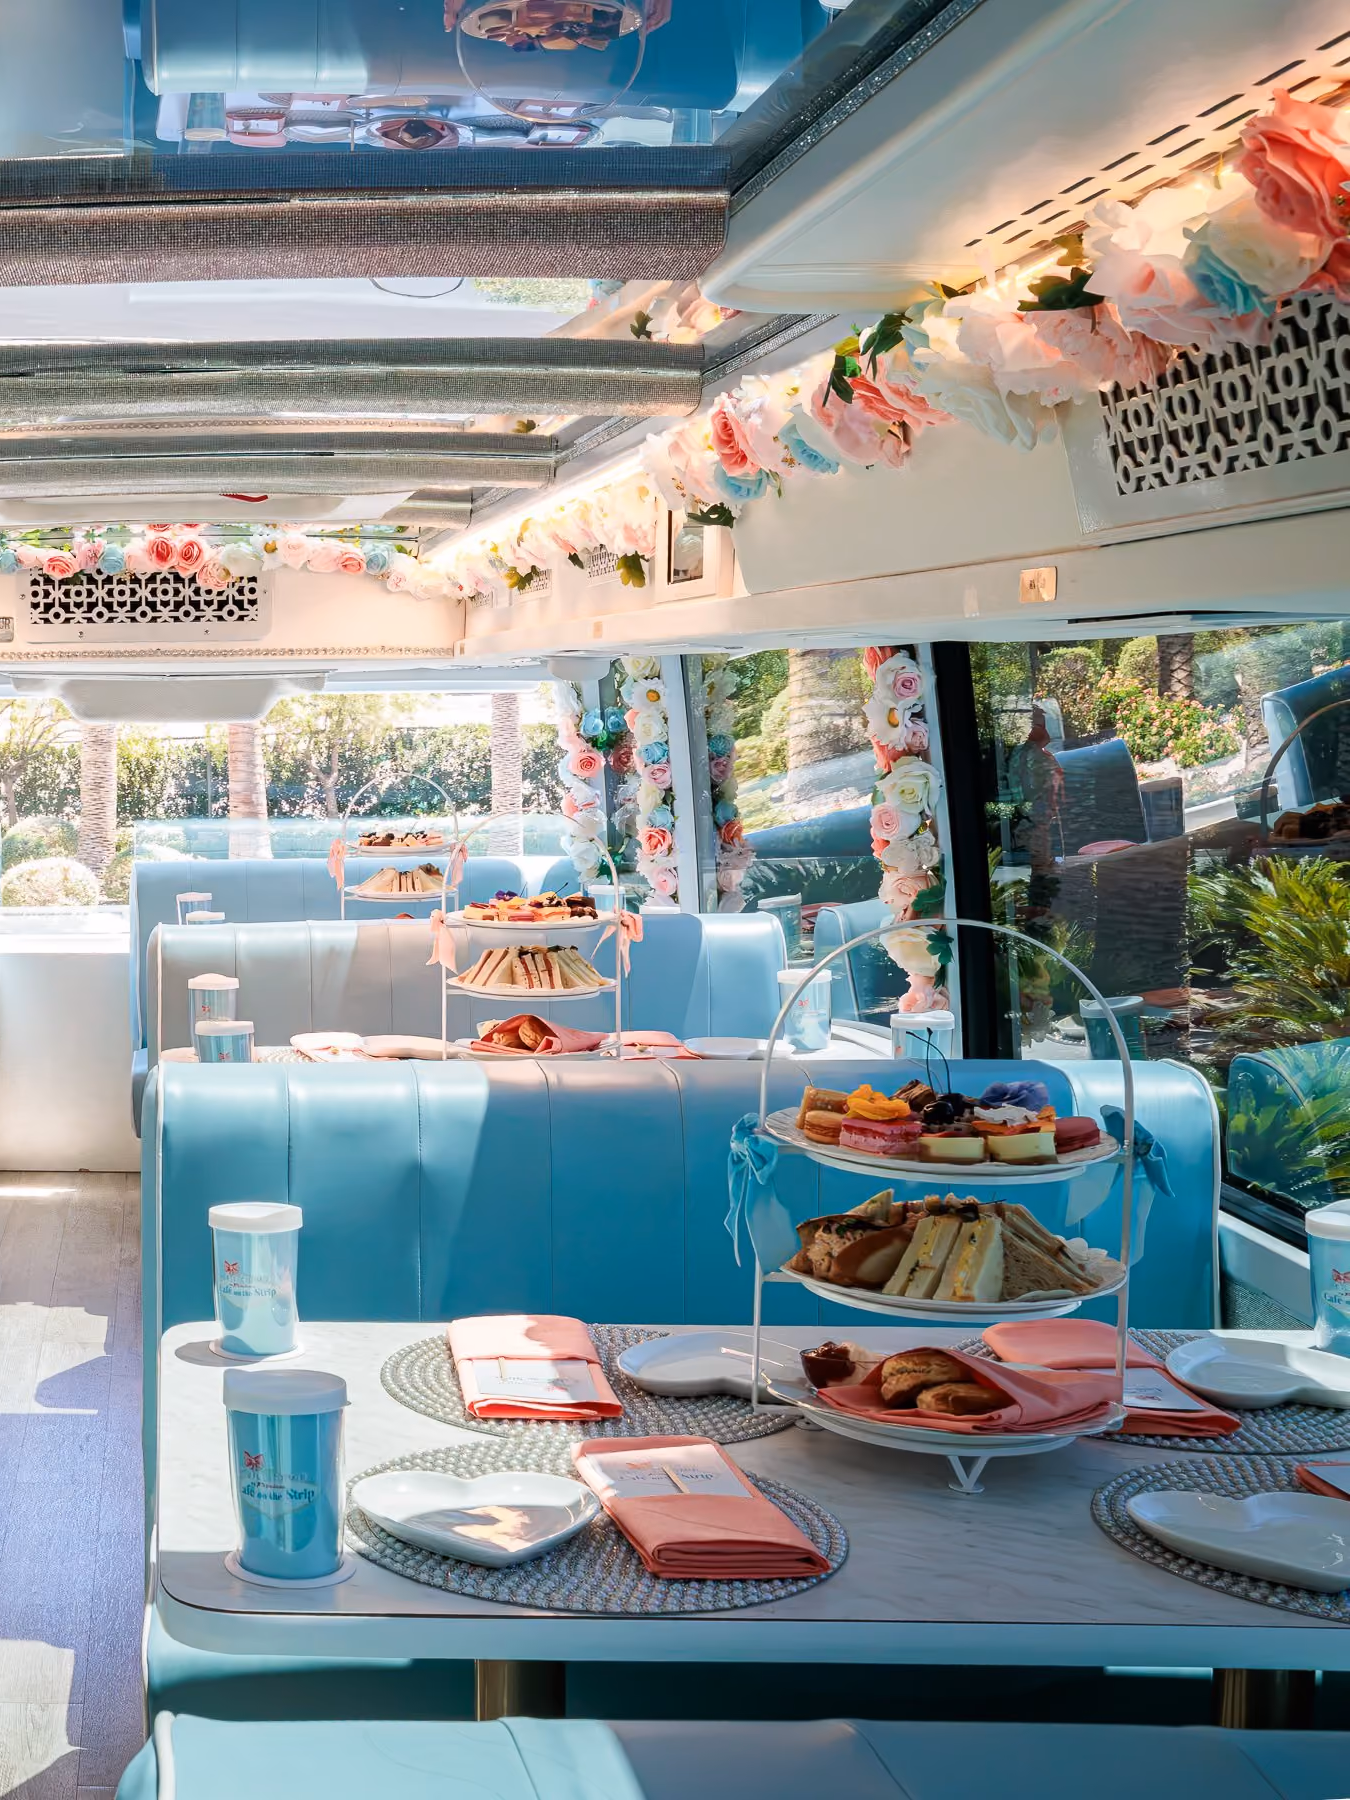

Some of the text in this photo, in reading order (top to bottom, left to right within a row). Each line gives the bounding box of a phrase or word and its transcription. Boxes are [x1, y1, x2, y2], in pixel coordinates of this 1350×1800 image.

[254, 1287, 277, 1299] Strip
[256, 1491, 268, 1499] on
[269, 1490, 283, 1501] the
[286, 1487, 315, 1503] Strip
